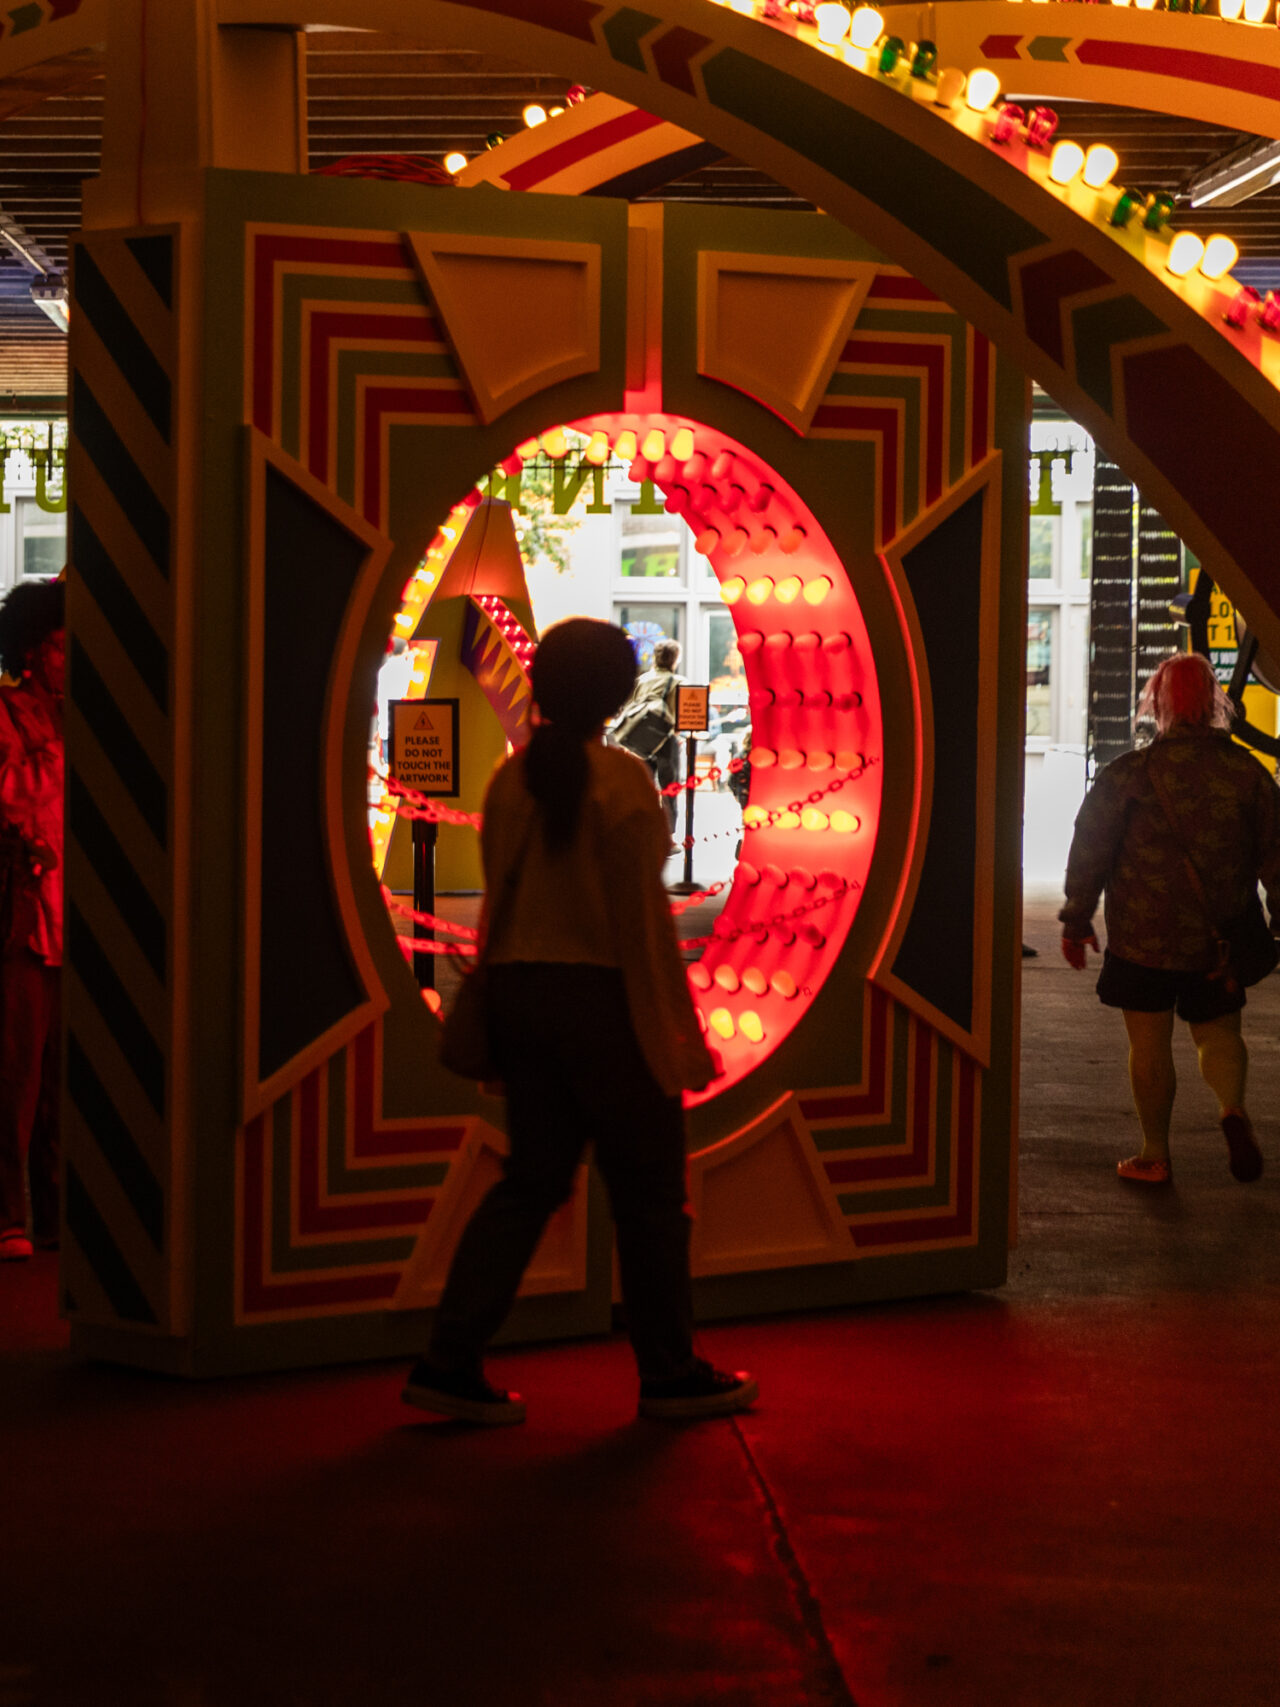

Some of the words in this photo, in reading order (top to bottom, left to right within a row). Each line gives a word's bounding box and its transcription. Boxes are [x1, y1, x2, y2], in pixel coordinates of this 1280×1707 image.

[405, 736, 439, 745] PLEASE
[405, 749, 420, 757] DO
[422, 749, 442, 757] NOT
[397, 761, 431, 770] TOUCH
[433, 761, 450, 770] THE
[400, 774, 449, 783] ARTWORK
